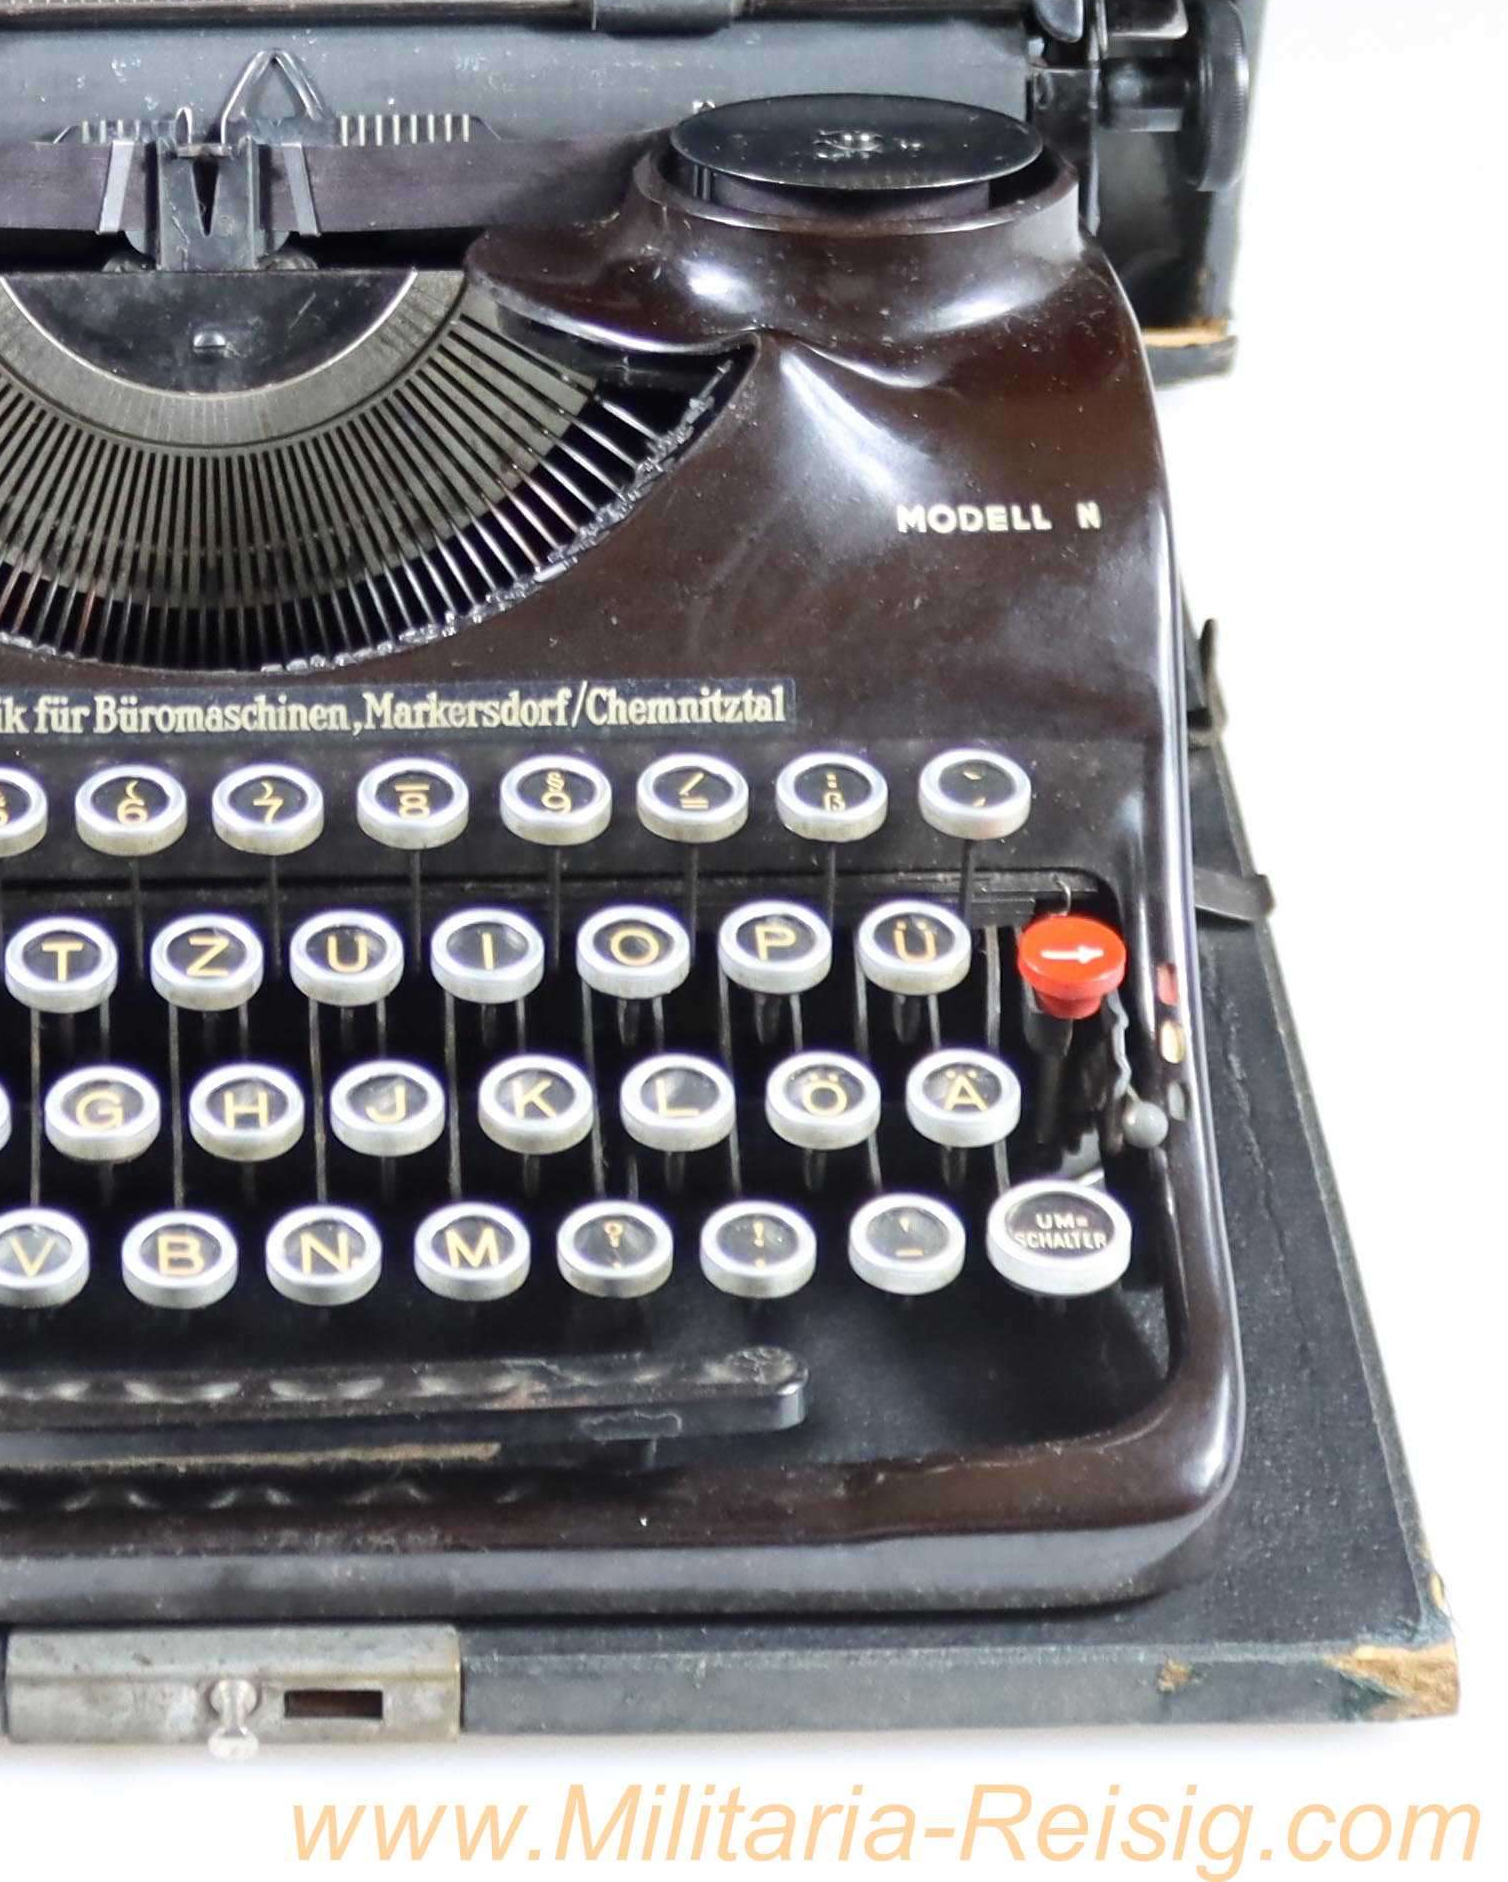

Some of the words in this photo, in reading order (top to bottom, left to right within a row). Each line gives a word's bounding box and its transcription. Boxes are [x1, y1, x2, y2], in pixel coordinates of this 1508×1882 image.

[895, 502, 1053, 534] MODELL
[1075, 500, 1102, 530] N
[32, 695, 91, 735] für
[545, 770, 566, 792] §
[116, 798, 148, 824] 6
[252, 797, 285, 824] 7
[398, 793, 430, 819] 8
[540, 791, 573, 814] 9
[42, 939, 84, 982] T
[188, 935, 229, 977] Z
[326, 934, 370, 973] U
[482, 933, 495, 971] I
[608, 926, 661, 967] O
[756, 924, 798, 962] P
[893, 921, 938, 963] Ü
[74, 1090, 125, 1130] G
[223, 1091, 270, 1130] H
[365, 1083, 406, 1123] J
[511, 1077, 558, 1120] K
[655, 1079, 698, 1118] L
[802, 1071, 848, 1116] Ö
[943, 1069, 987, 1113] Ä
[299, 1232, 350, 1275] N
[444, 1227, 500, 1270] M
[754, 1221, 765, 1246] !
[1014, 1231, 1107, 1249] SCHALTER
[10, 1236, 54, 1279] V
[156, 1233, 205, 1276] B
